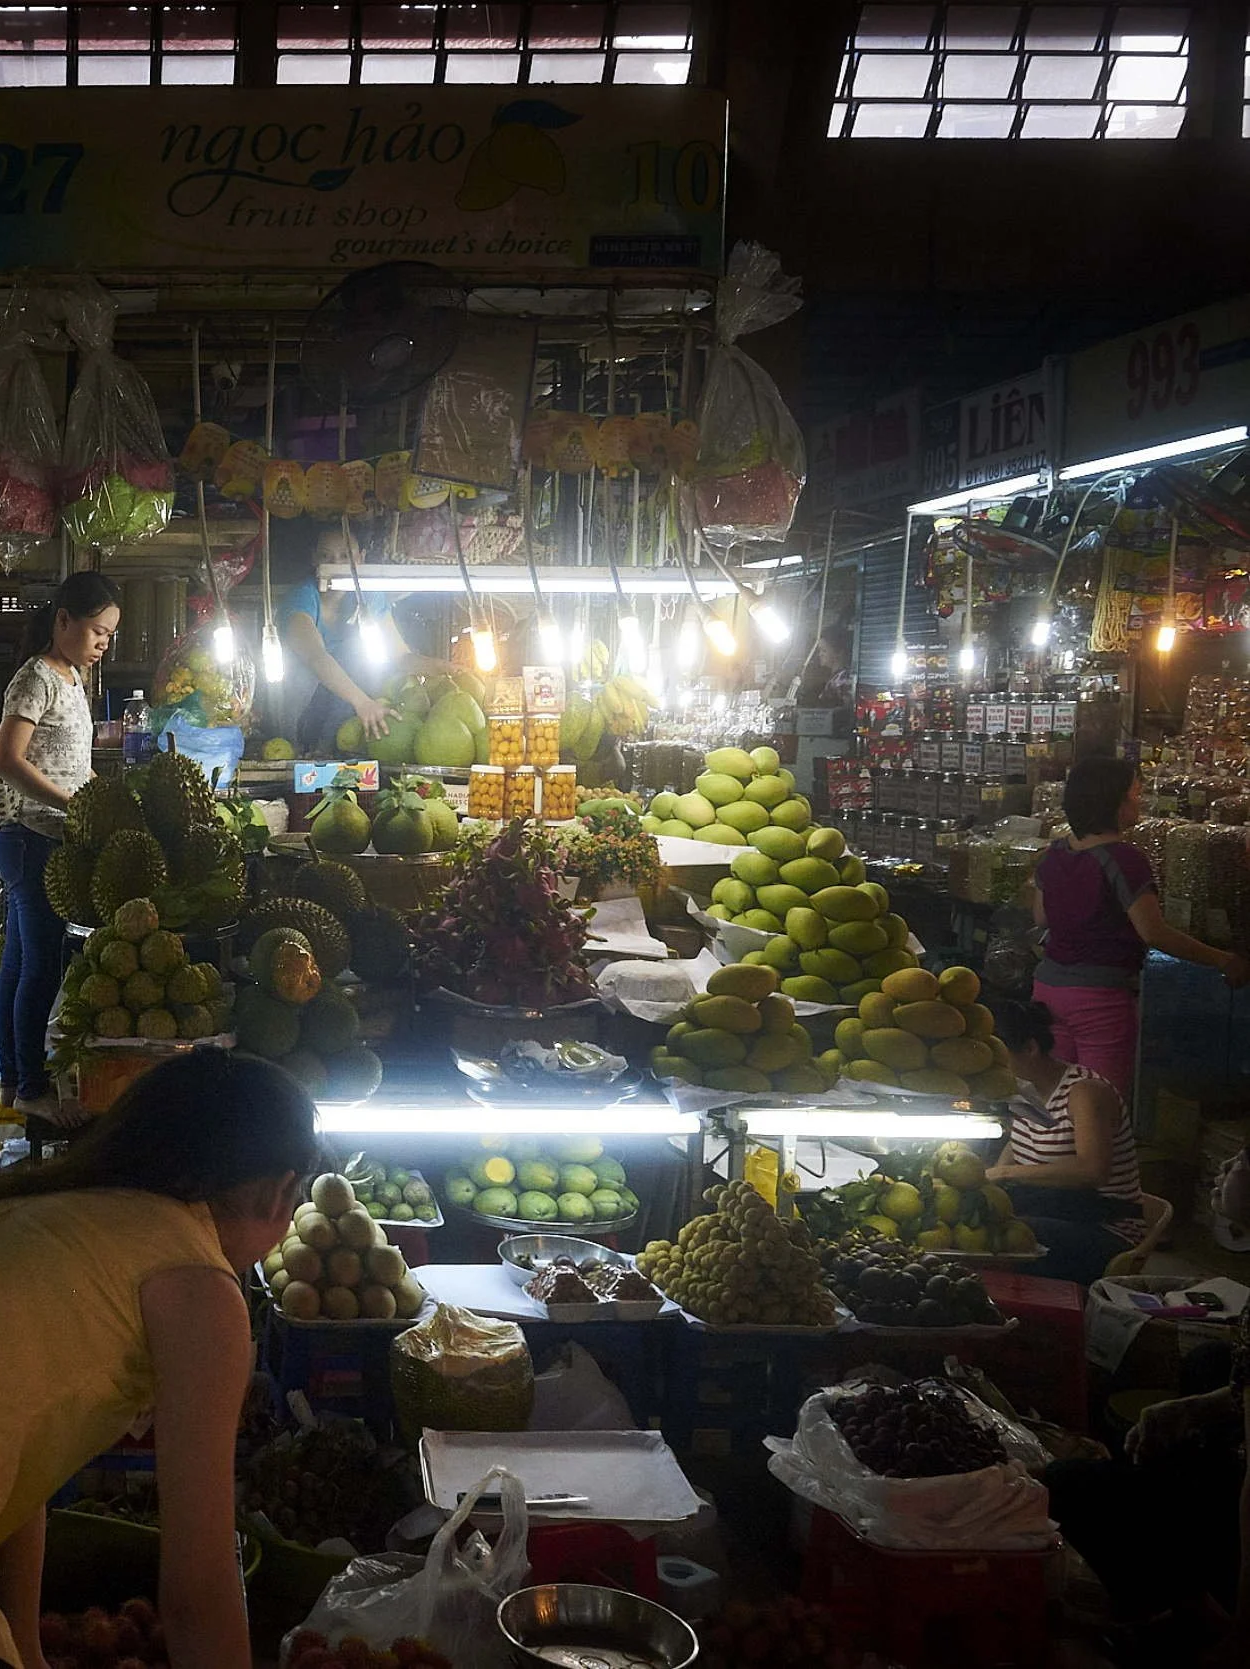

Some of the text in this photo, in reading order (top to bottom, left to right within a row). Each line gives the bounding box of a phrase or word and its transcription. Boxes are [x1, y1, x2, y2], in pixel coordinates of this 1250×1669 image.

[340, 101, 466, 165] hảo
[225, 197, 428, 233] fruit shop
[329, 230, 574, 263] gourmet's choice
[1126, 322, 1199, 420] 993
